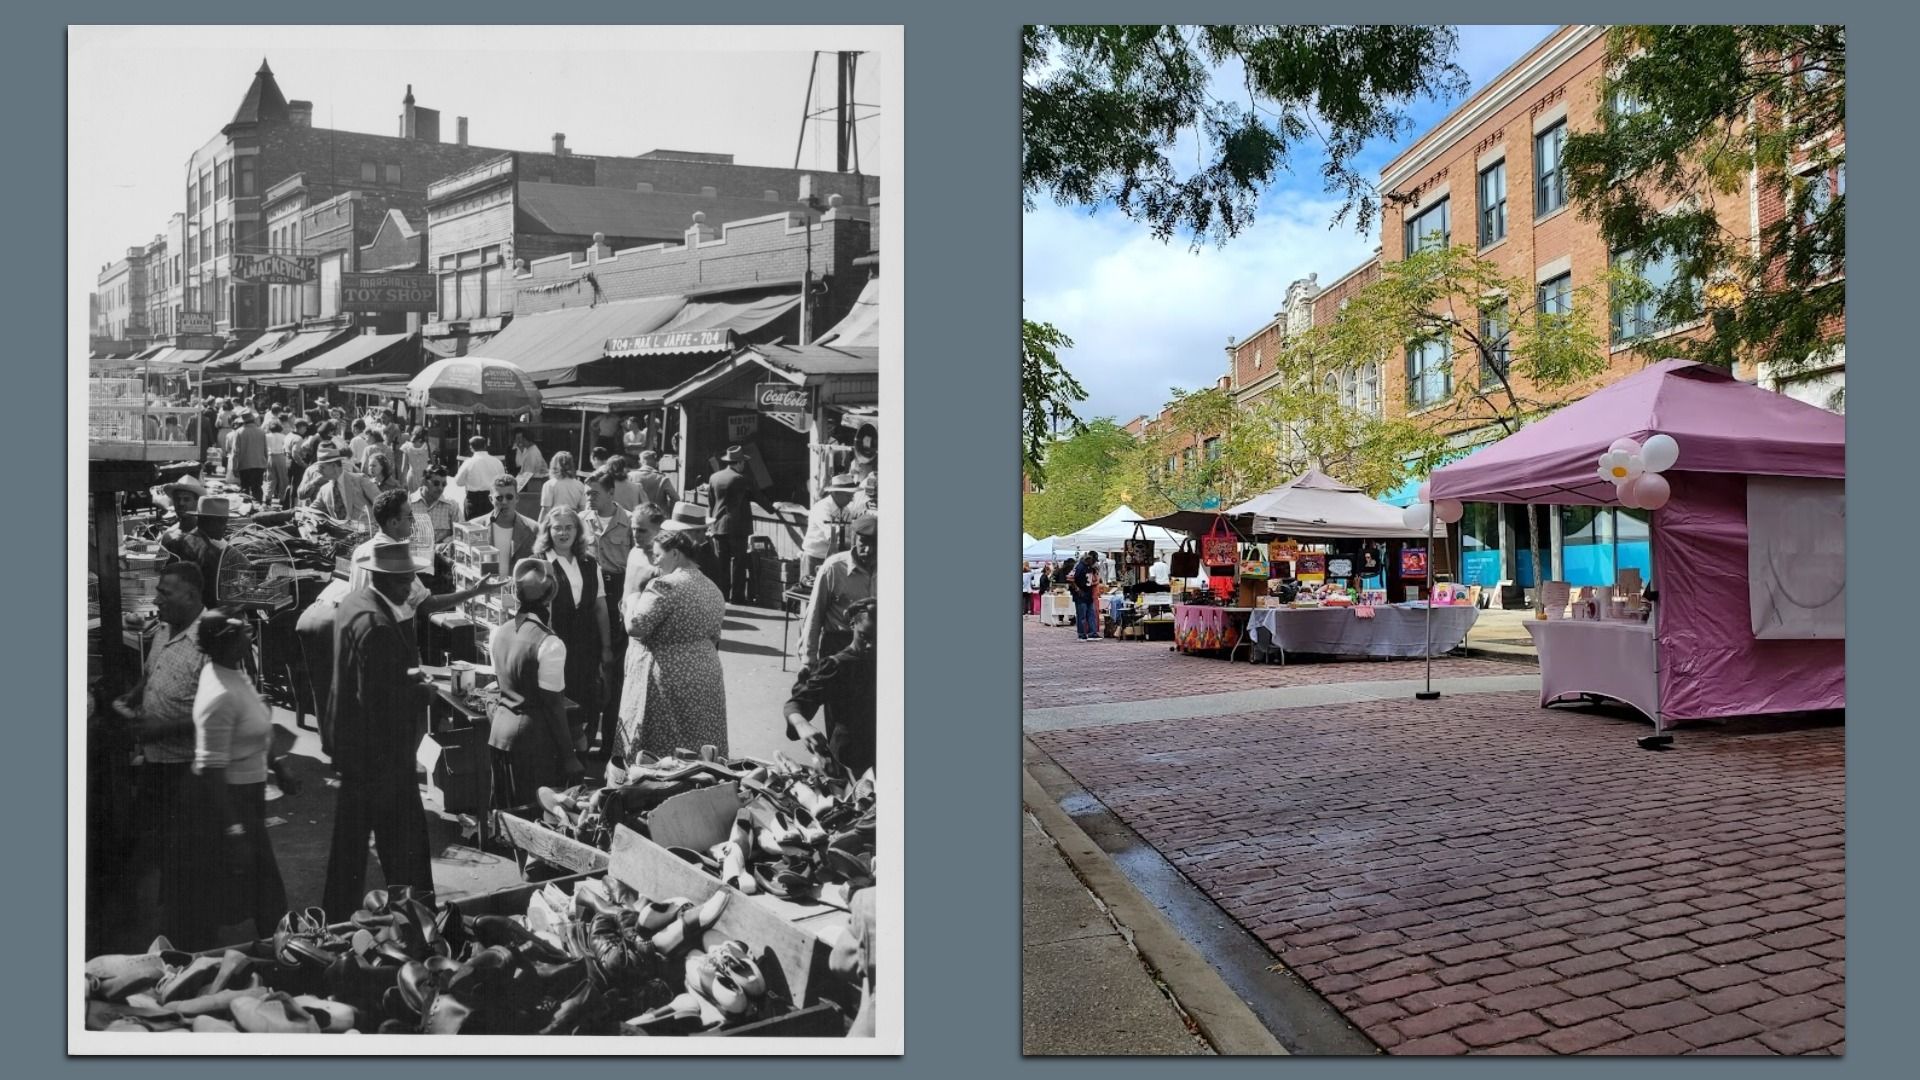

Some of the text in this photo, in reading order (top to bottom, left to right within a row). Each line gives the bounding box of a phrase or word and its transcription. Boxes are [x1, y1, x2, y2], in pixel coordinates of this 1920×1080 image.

[344, 288, 433, 302] TOY SHOP
[612, 339, 628, 350] 704
[701, 331, 719, 345] 704
